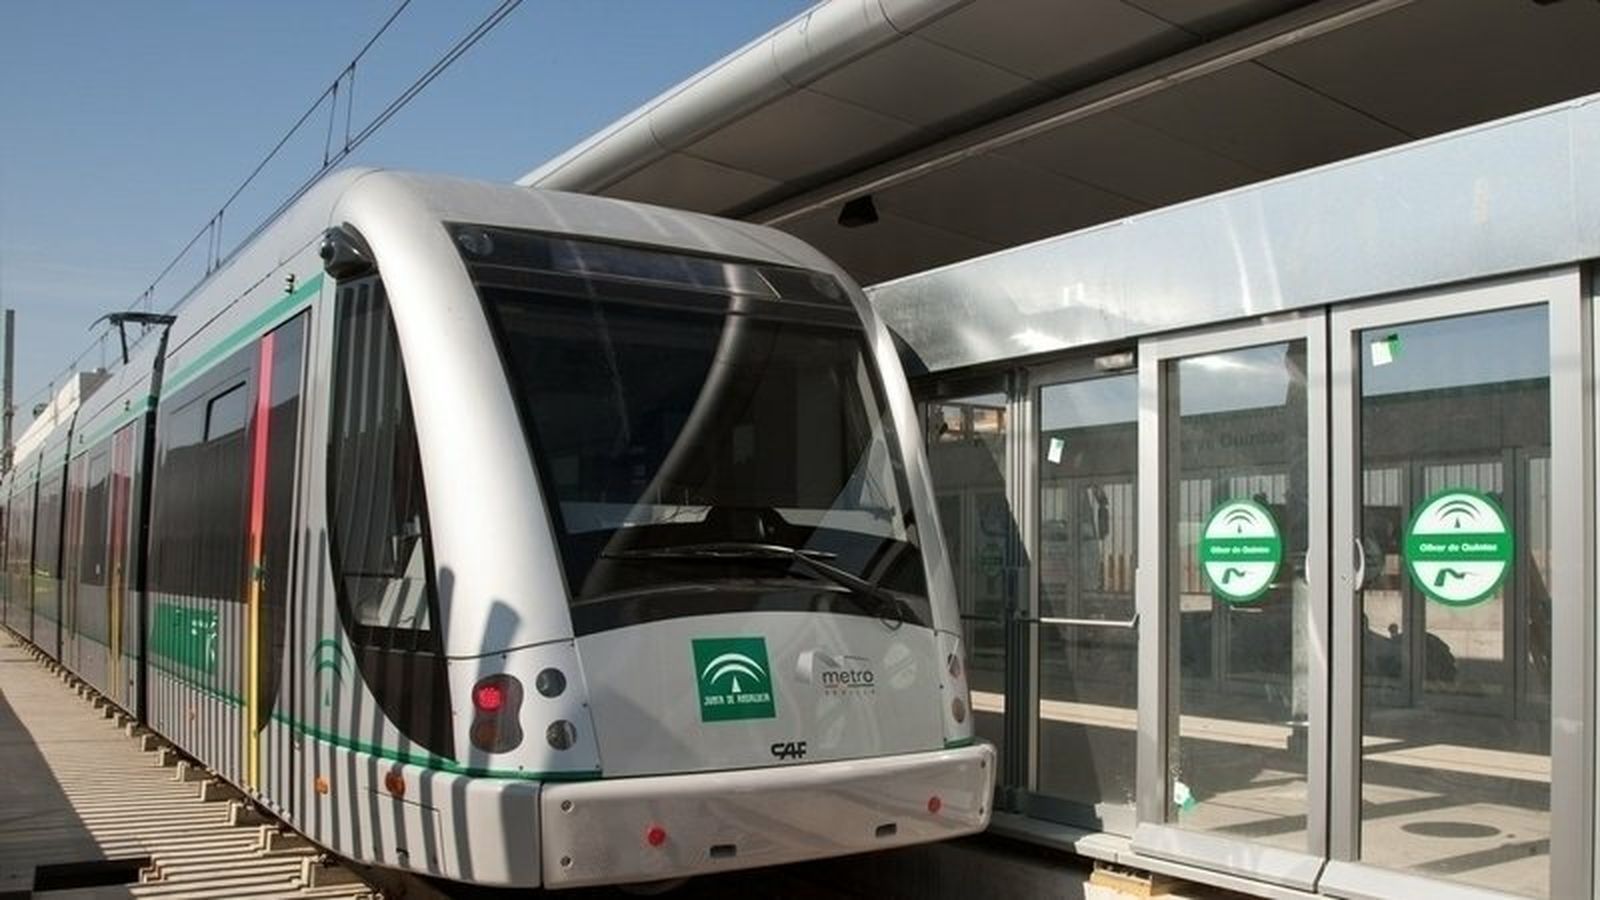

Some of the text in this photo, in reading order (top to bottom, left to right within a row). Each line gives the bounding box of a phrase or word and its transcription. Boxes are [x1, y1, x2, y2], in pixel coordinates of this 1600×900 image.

[1448, 543, 1459, 553] de
[822, 669, 874, 684] metro
[703, 694, 724, 706] JUNTA
[725, 694, 735, 705] DE
[771, 742, 807, 760] CAF
